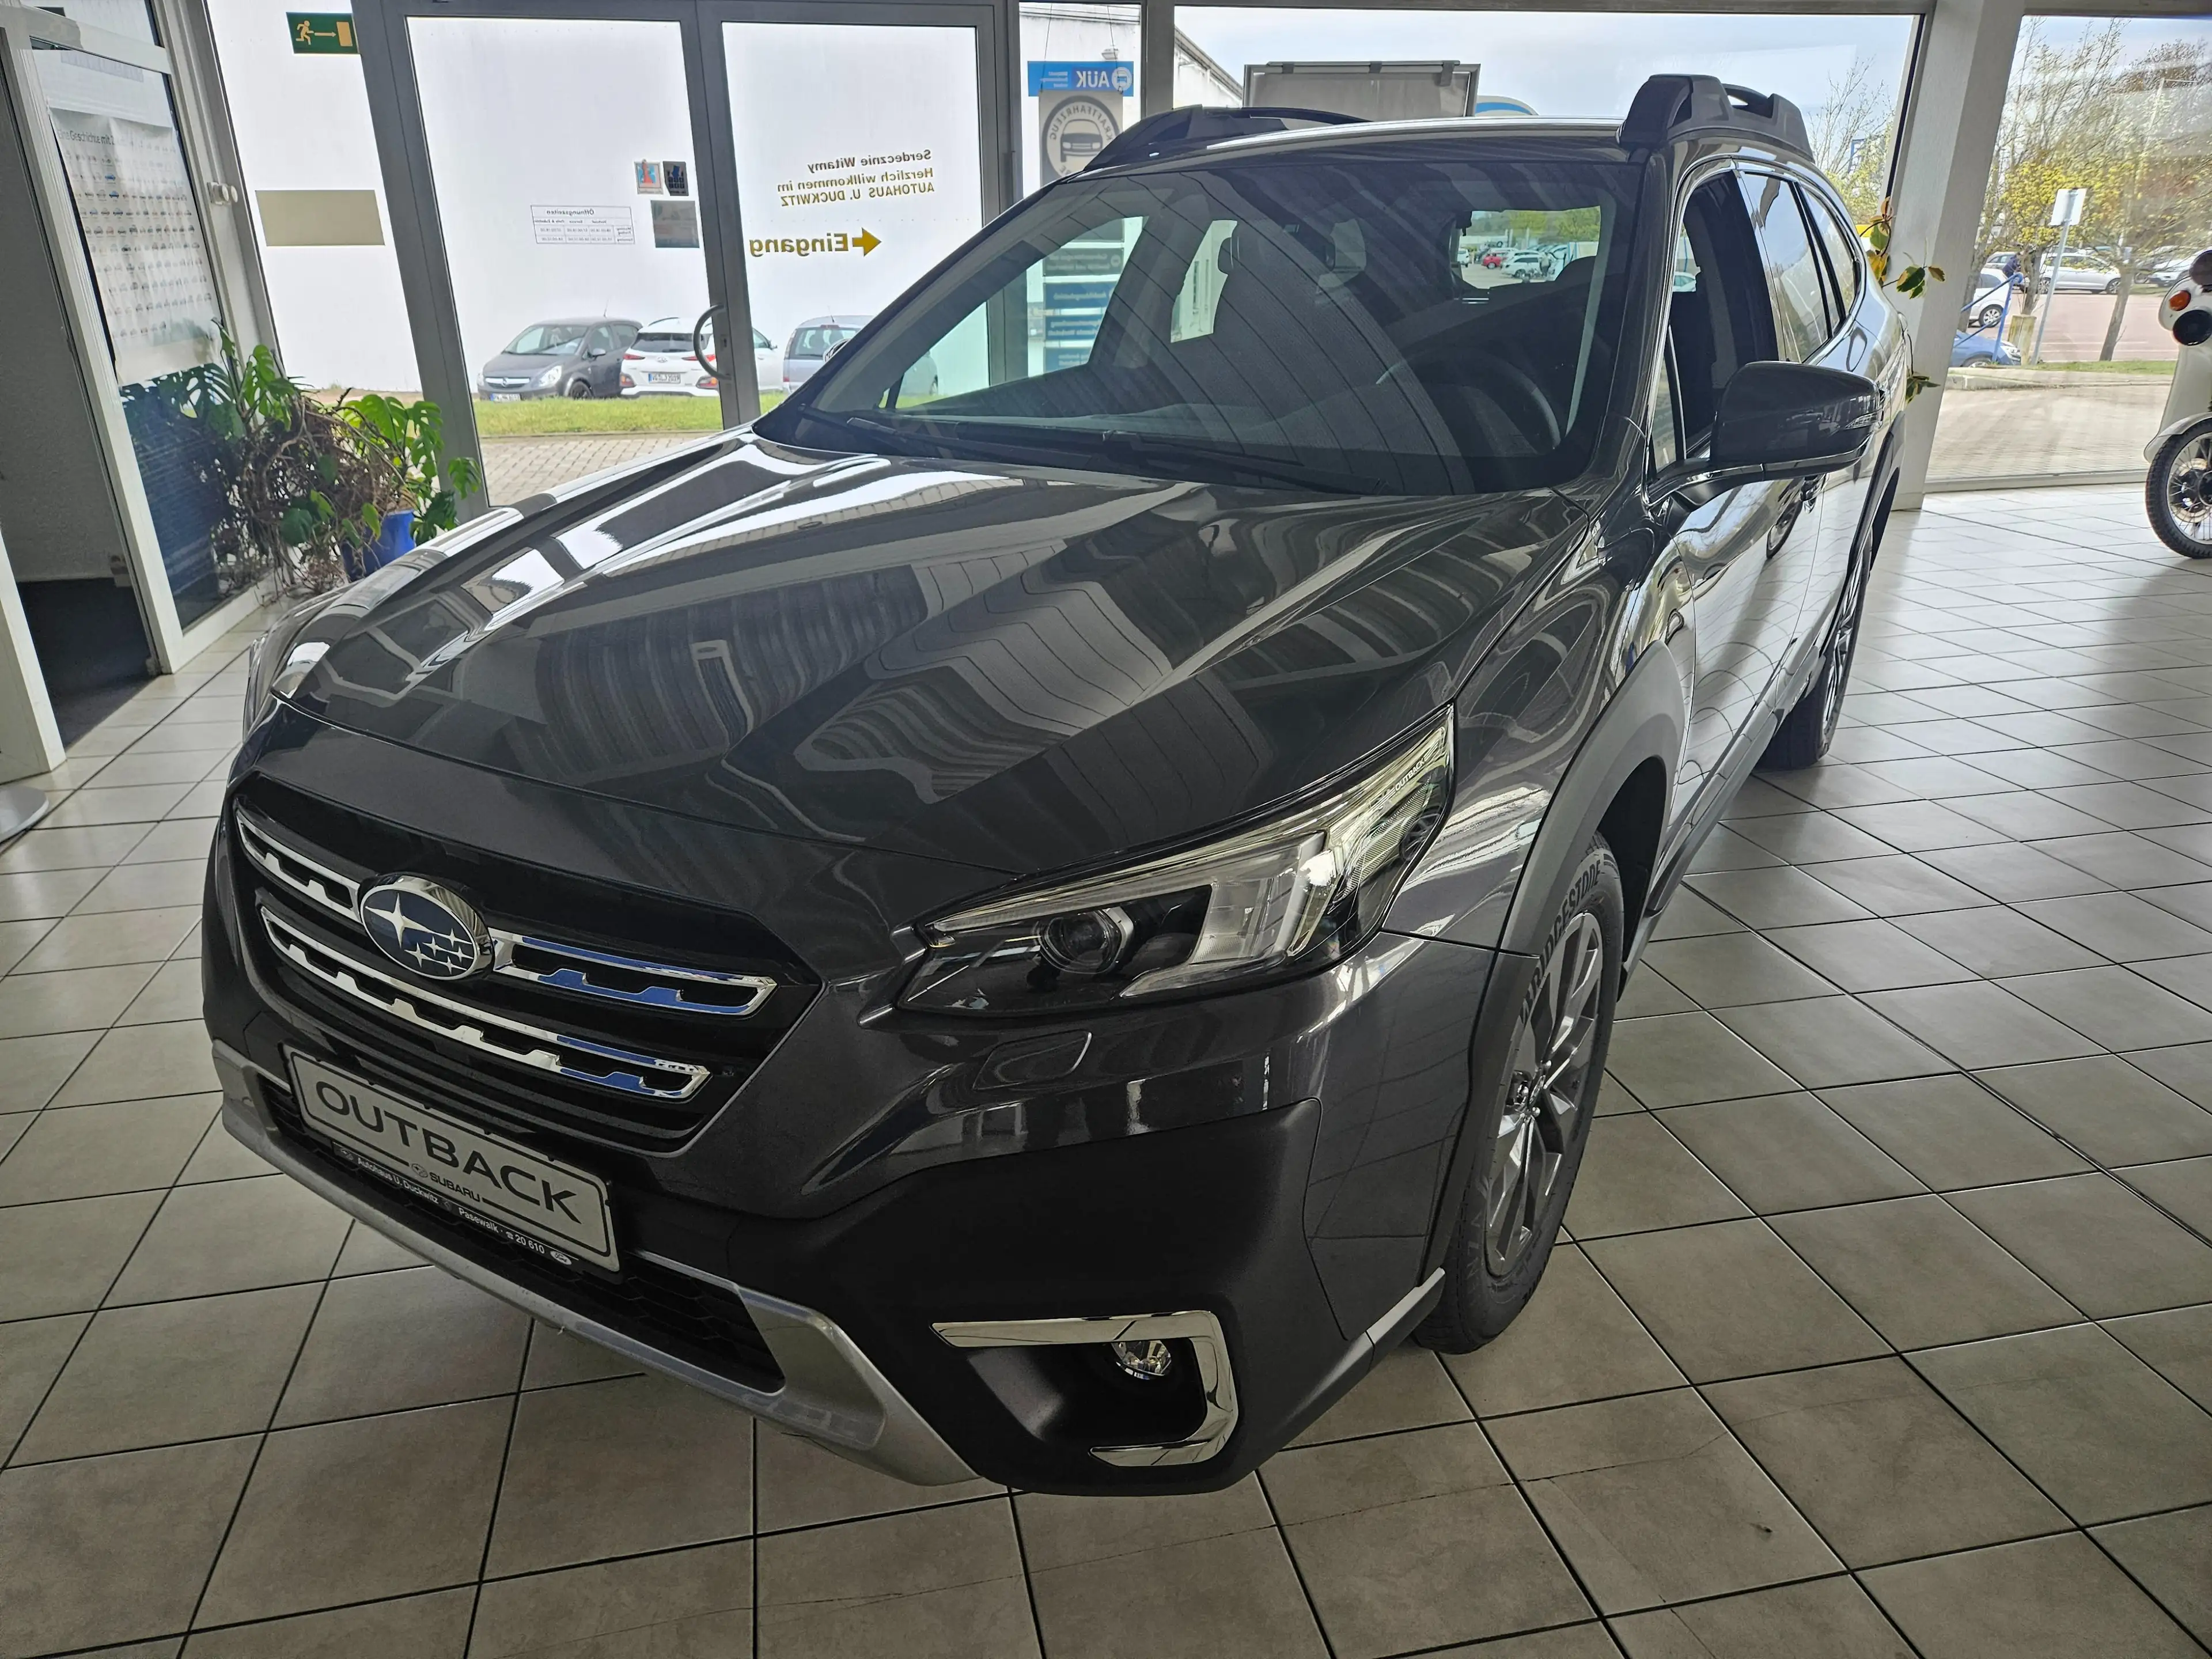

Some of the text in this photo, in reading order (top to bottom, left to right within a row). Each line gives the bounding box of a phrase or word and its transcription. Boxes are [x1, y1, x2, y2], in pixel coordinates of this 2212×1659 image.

[1395, 757, 1425, 791] OUTBACK
[315, 1081, 582, 1225] OUTBACK
[357, 1157, 545, 1254] Autohaus U. Duckwitz Pasewalk 20 610
[430, 1172, 481, 1203] SUBARU
